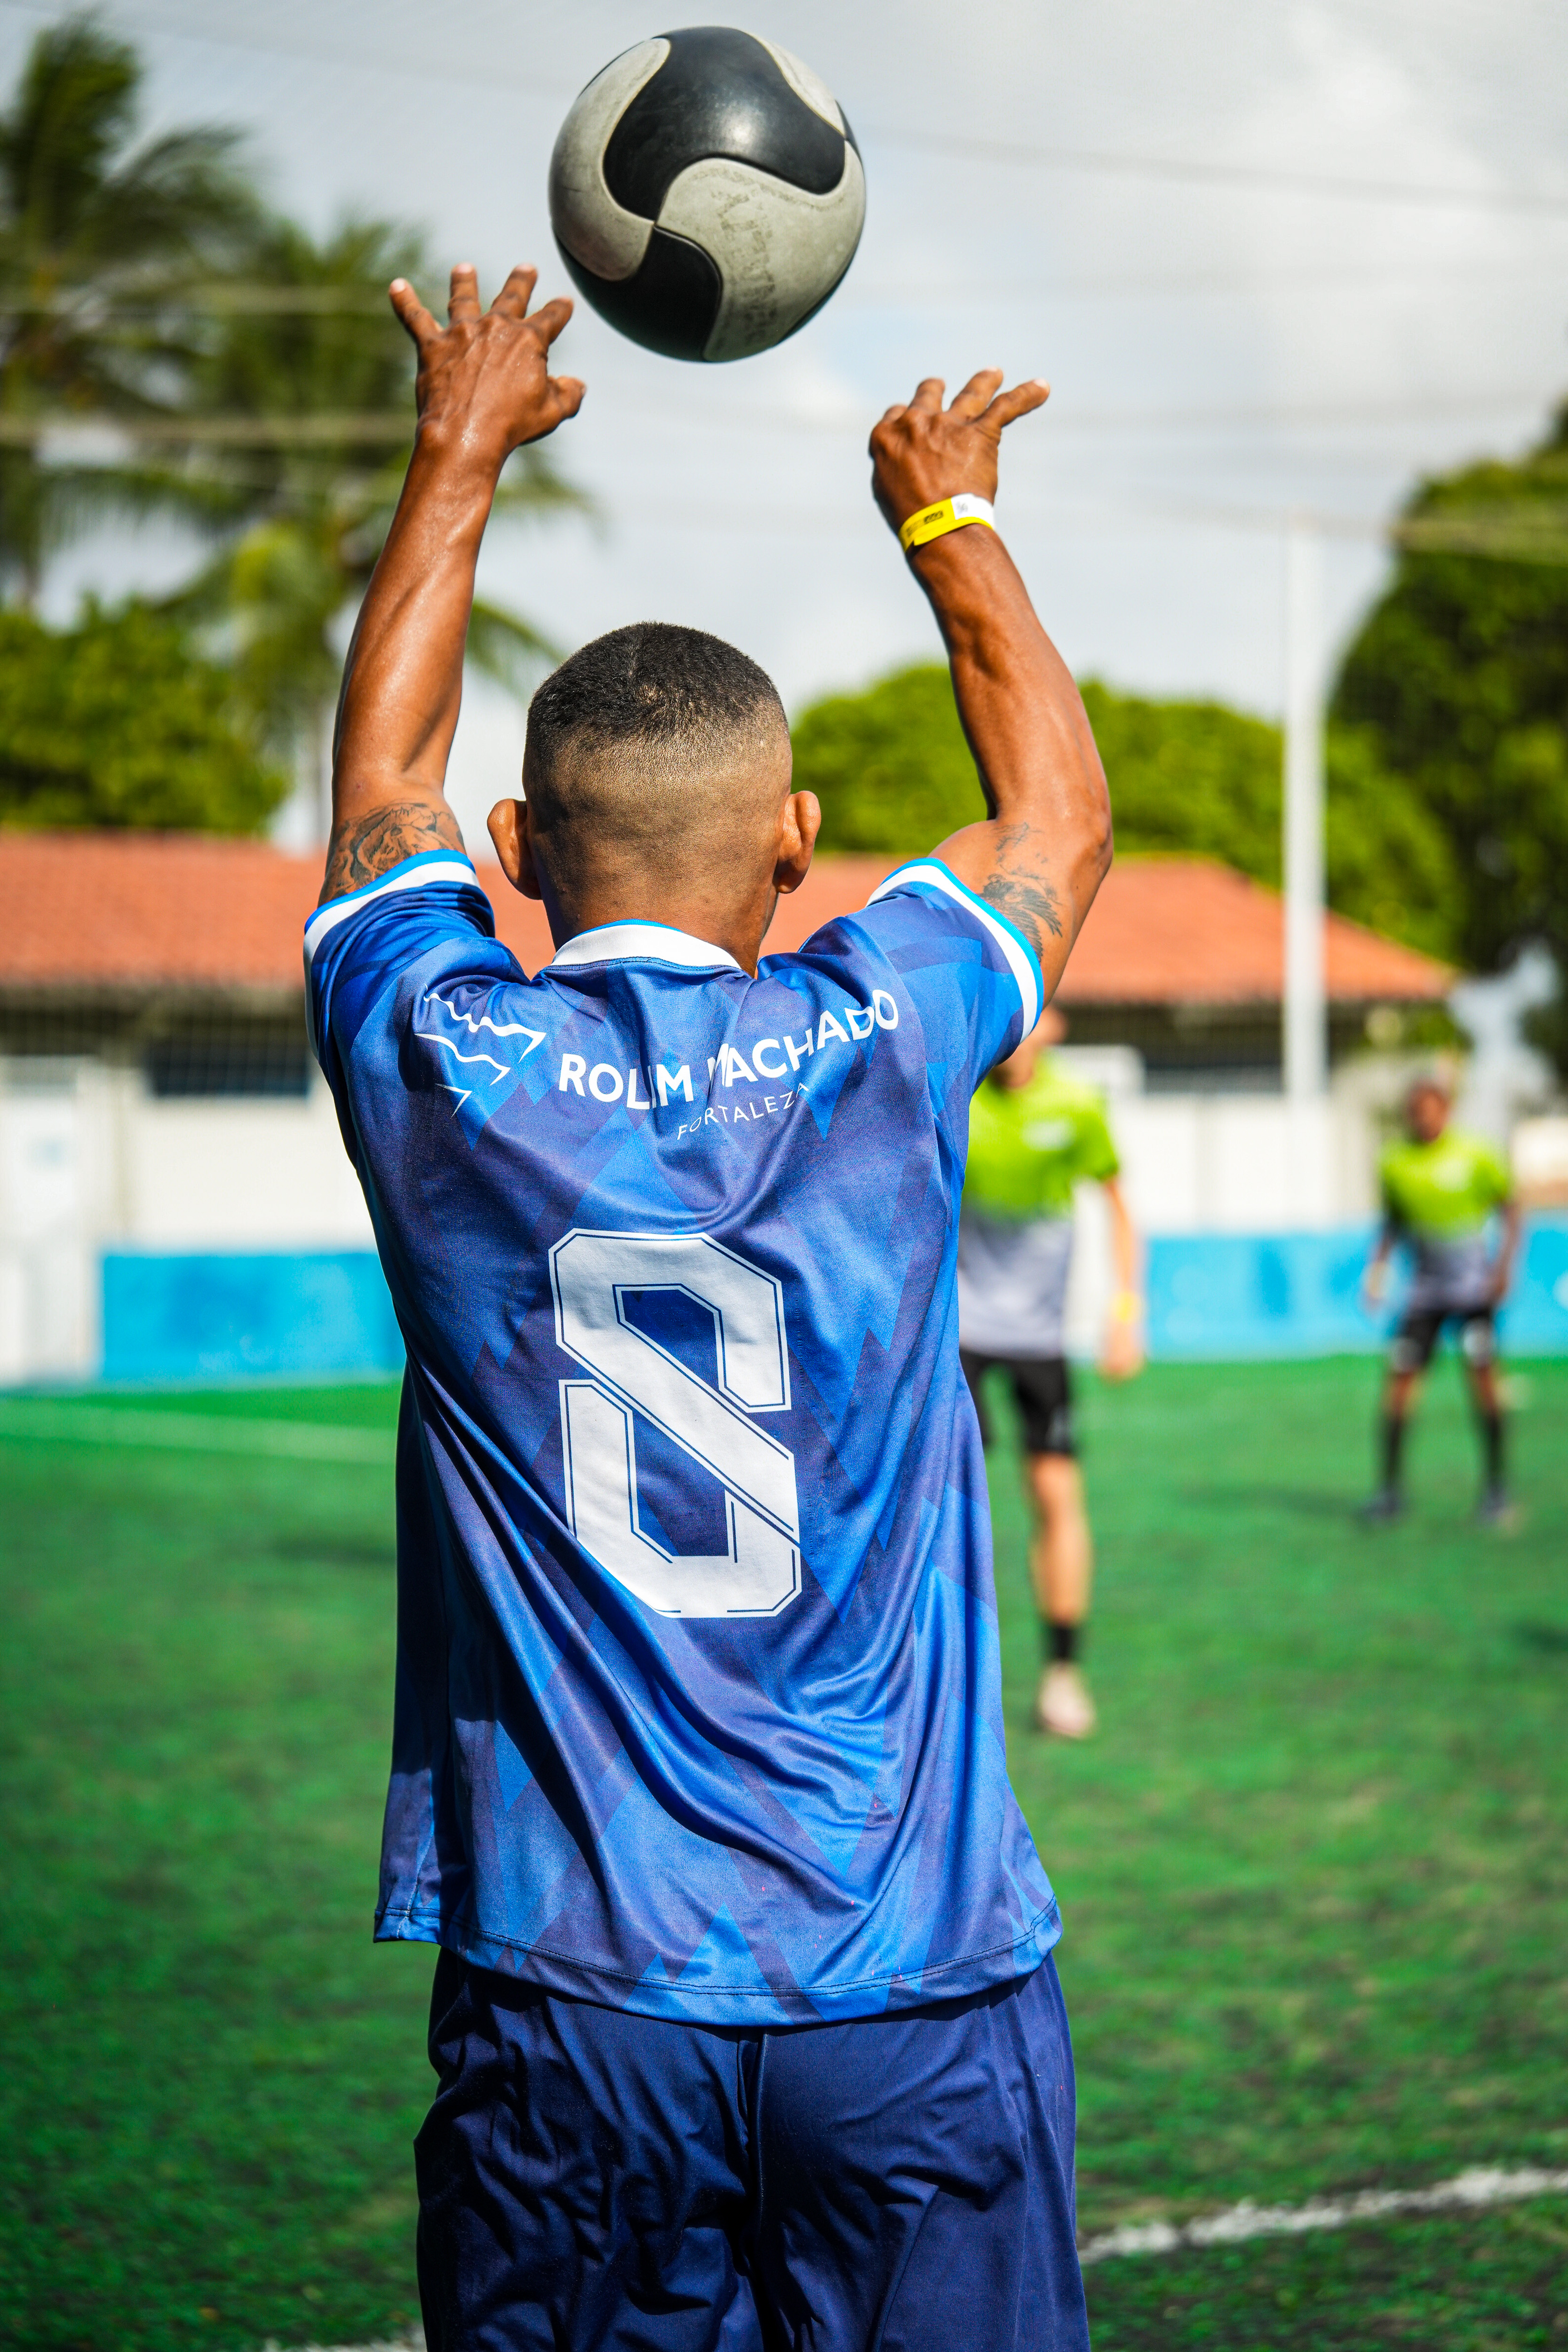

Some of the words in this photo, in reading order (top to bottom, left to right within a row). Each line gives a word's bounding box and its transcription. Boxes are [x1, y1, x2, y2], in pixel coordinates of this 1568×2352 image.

[558, 1053, 694, 1110] ROLIM
[677, 1082, 810, 1140] FORTALEZA
[548, 1228, 803, 1618] 8
